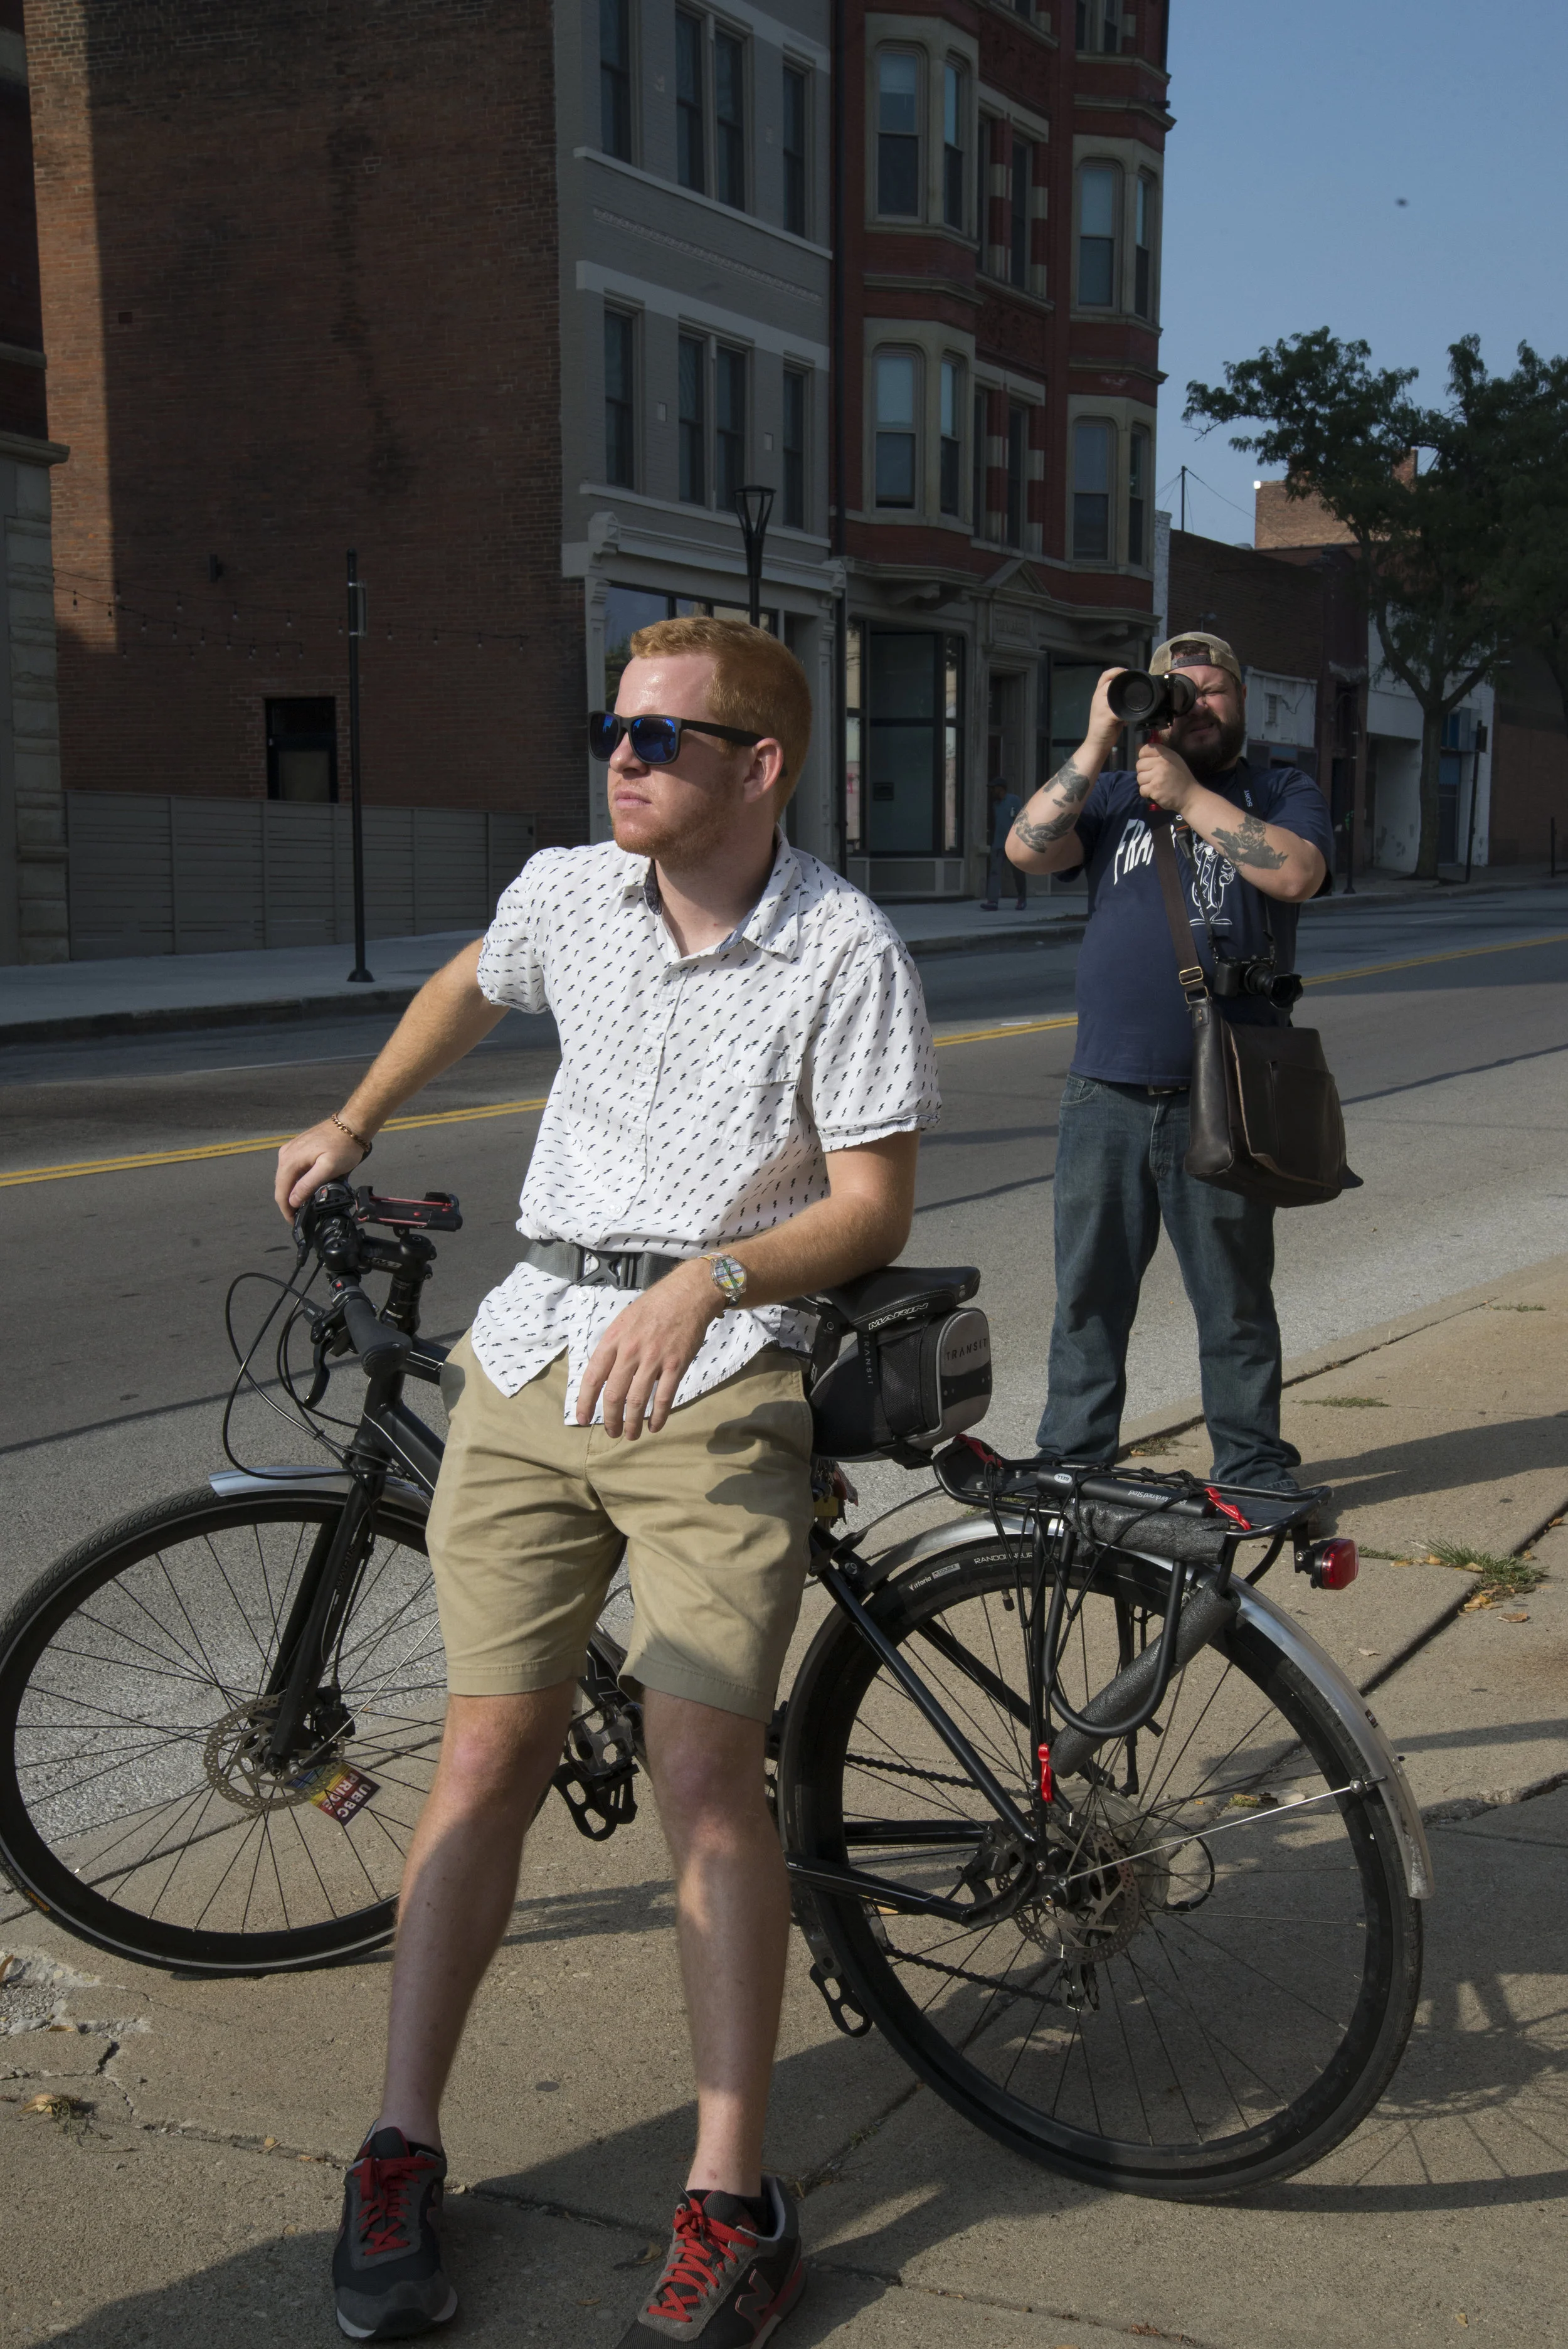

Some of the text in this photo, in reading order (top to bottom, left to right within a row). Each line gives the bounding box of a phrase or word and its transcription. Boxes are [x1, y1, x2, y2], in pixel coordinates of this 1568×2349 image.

[1244, 789, 1253, 808] SONY
[869, 1302, 929, 1330] MARIN
[862, 1334, 874, 1385] TRANSIT
[946, 1338, 988, 1361] TRANSIT
[1128, 1490, 1144, 1498] Steel
[909, 1576, 932, 1591] Vittoria
[321, 1773, 359, 1810] PRIDE
[337, 1783, 371, 1818] UBBC
